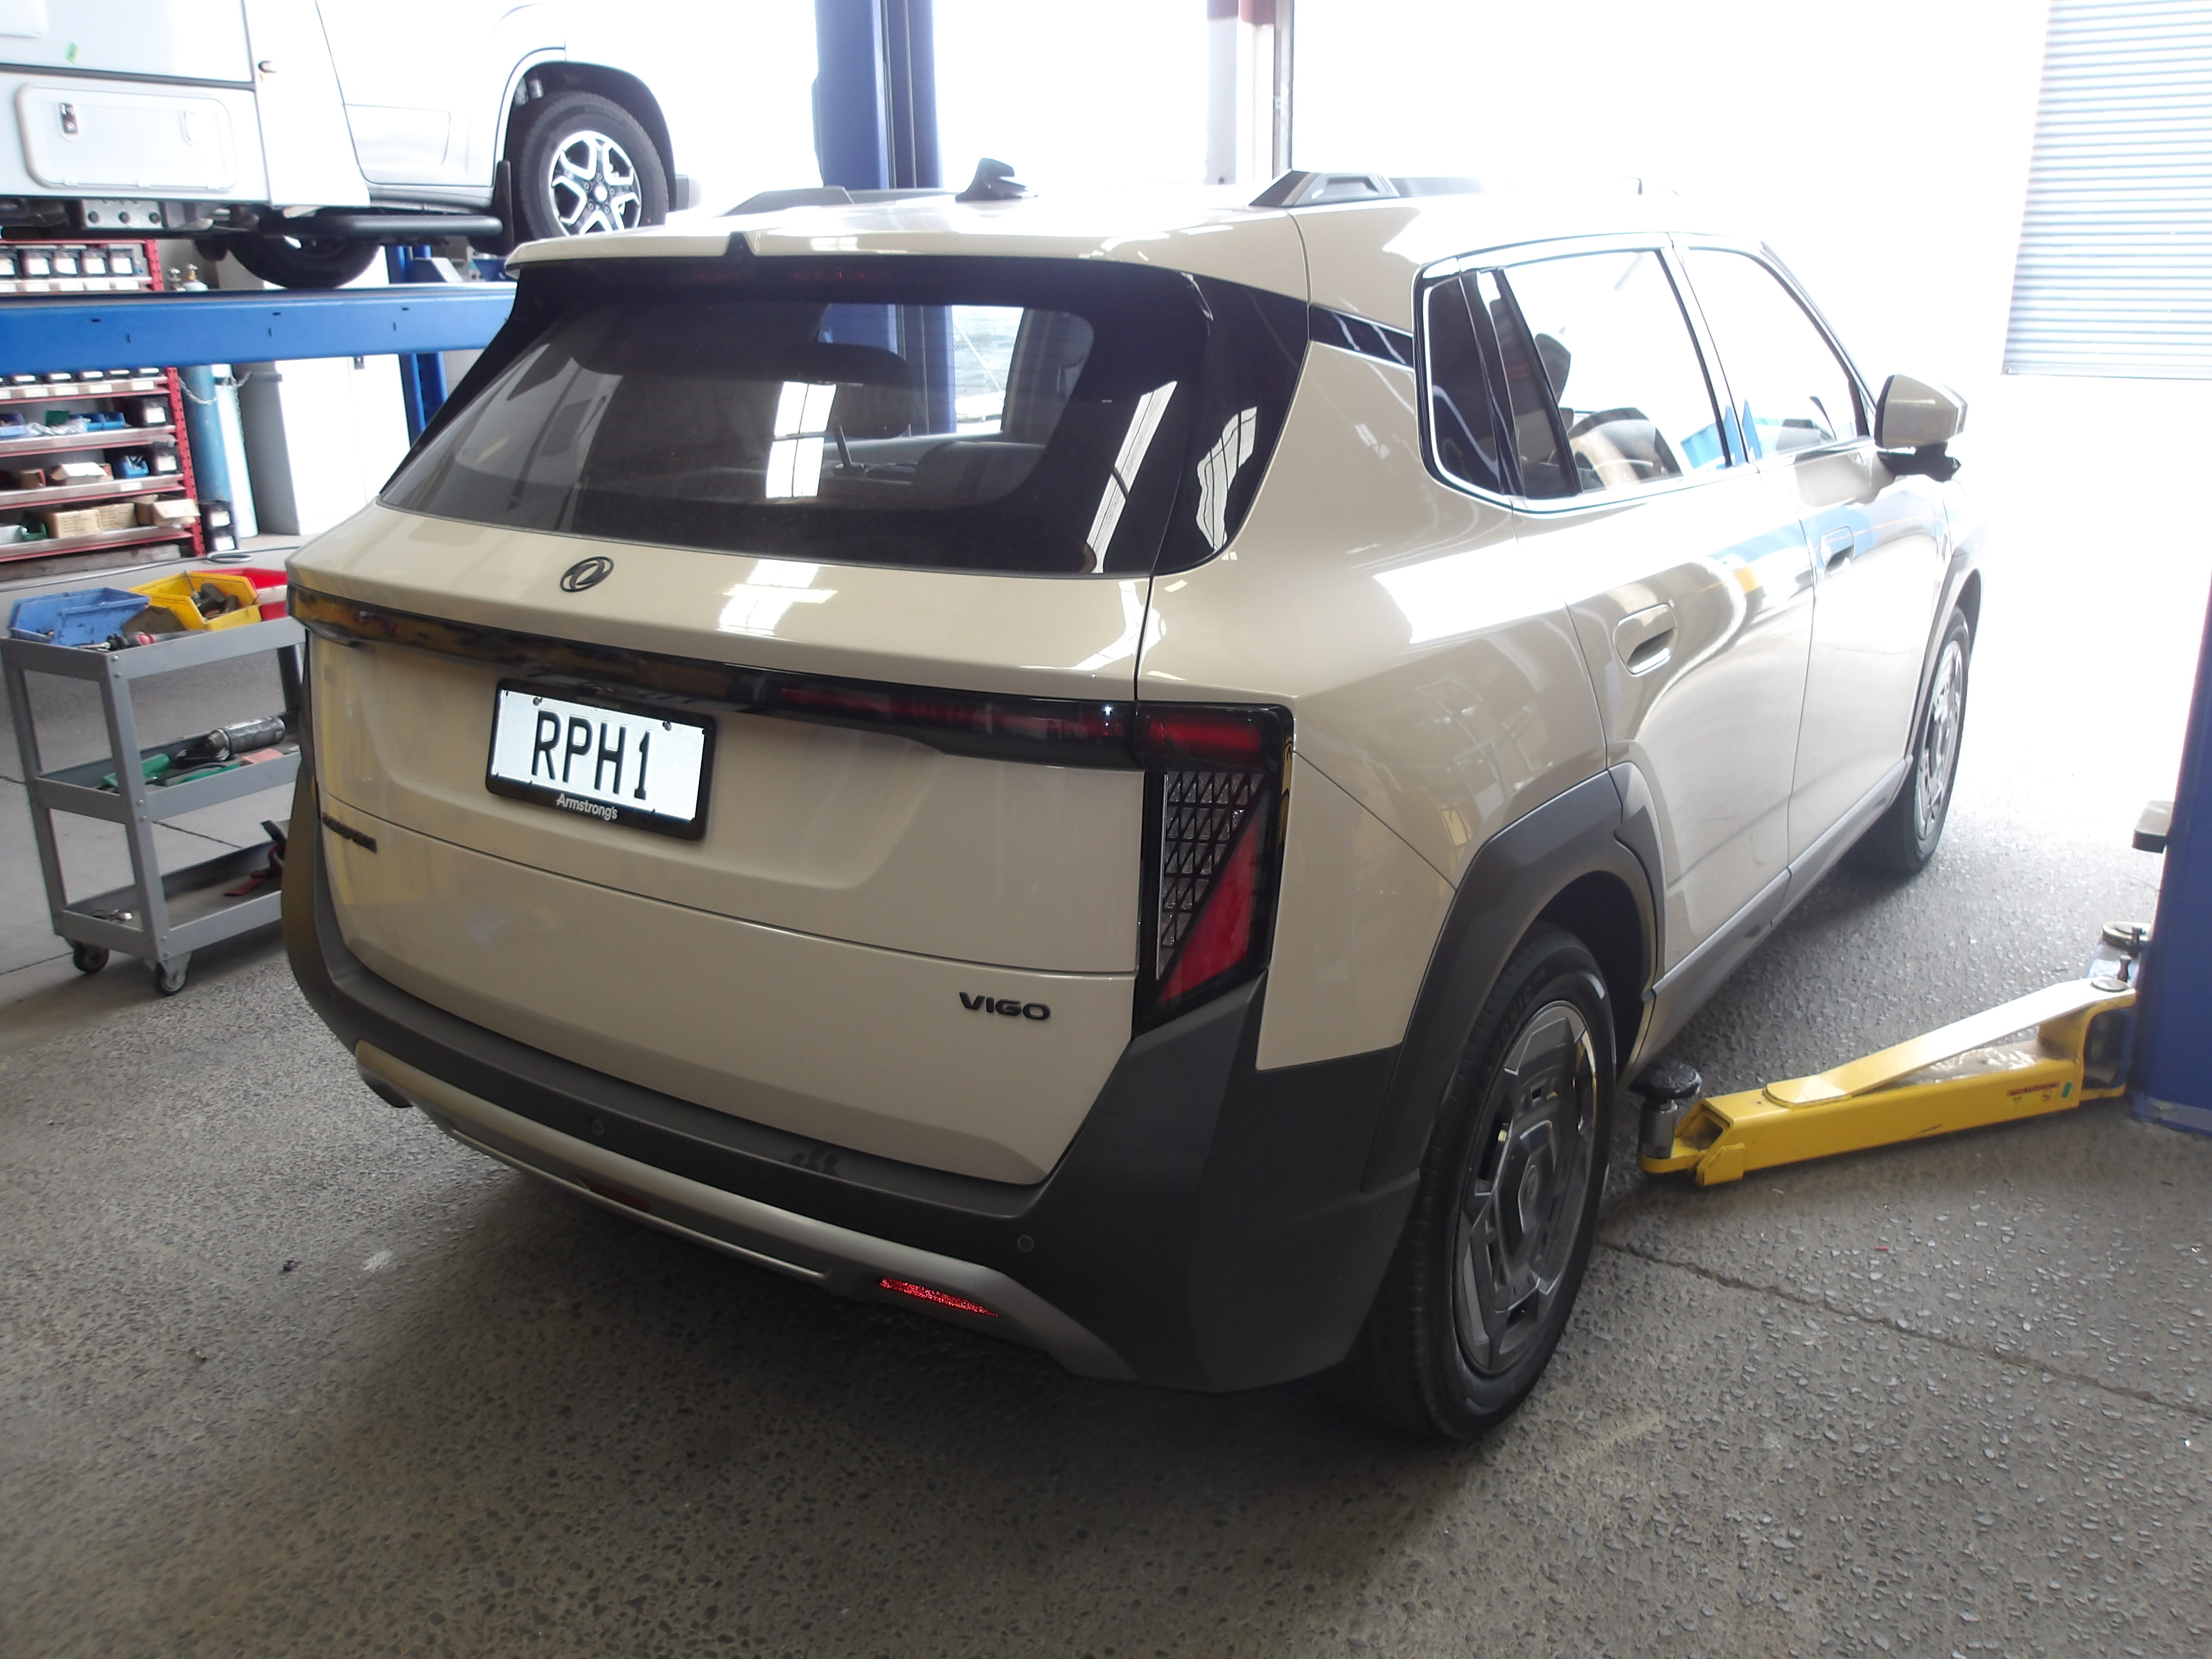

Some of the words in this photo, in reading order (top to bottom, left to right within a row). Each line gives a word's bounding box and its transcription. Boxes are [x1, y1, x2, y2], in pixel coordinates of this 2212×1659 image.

[531, 709, 651, 801] RPH1
[556, 793, 618, 821] Armstrong's
[959, 991, 1051, 1020] VIGO
